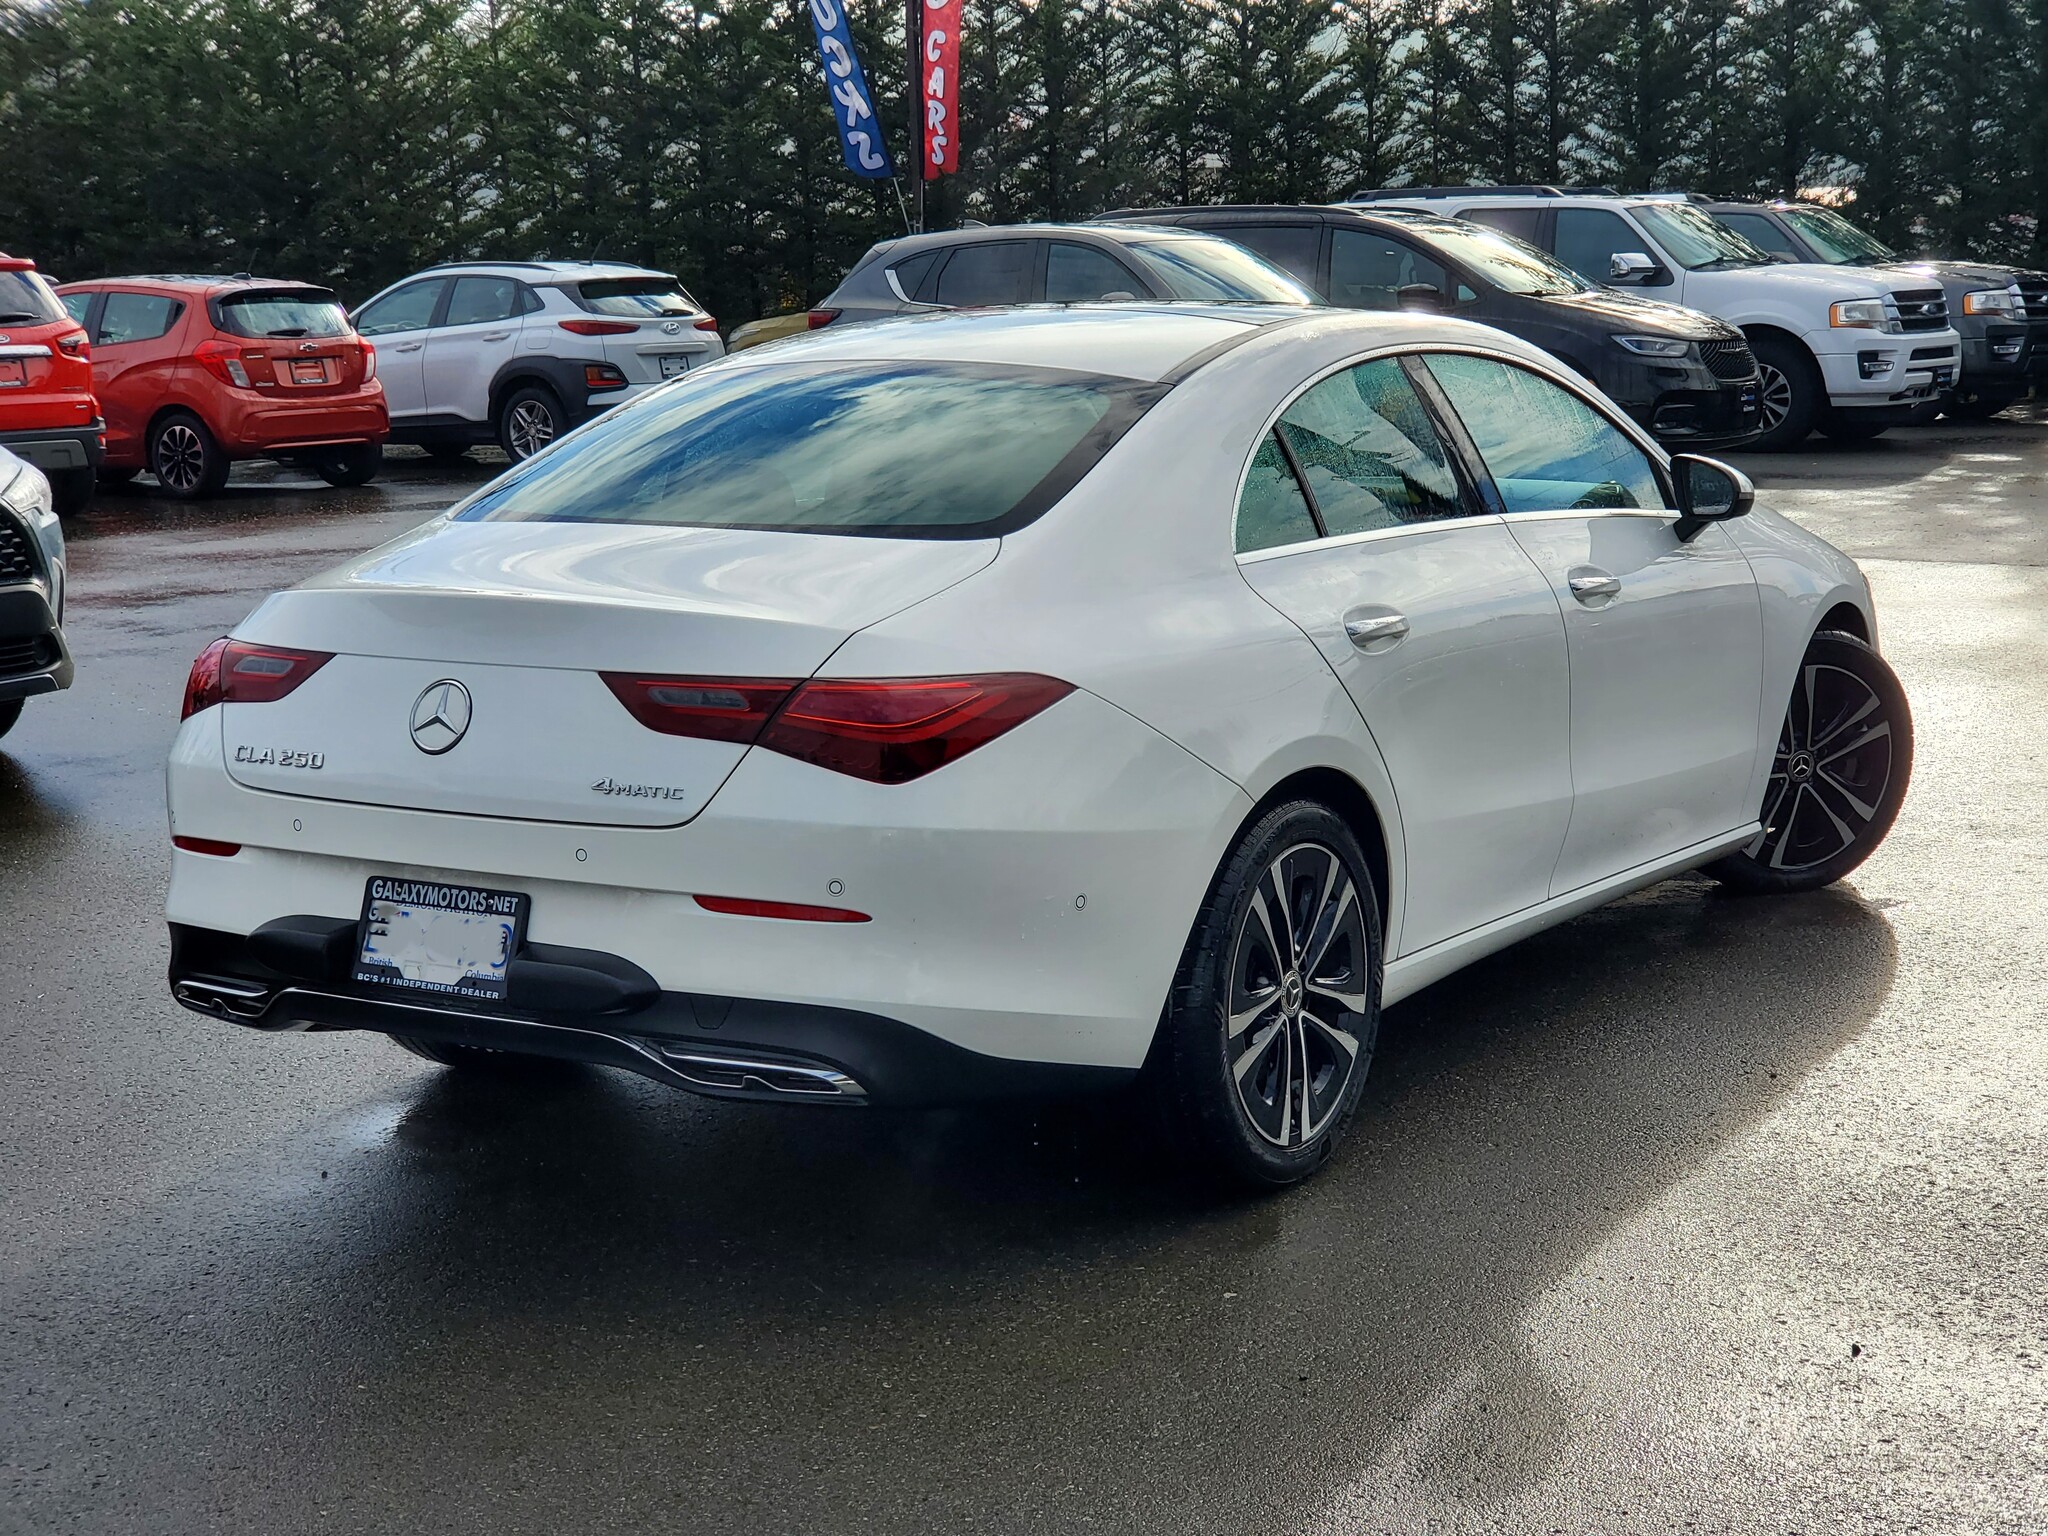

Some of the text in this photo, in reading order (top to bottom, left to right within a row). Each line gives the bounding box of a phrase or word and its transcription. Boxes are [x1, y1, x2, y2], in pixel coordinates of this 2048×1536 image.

[926, 30, 948, 165] CARS
[234, 745, 325, 769] CLA 250
[591, 777, 685, 800] 4MATIC
[357, 972, 379, 982] BC'S
[392, 977, 460, 994] INDEPENDENT
[461, 987, 500, 1000] DEALER
